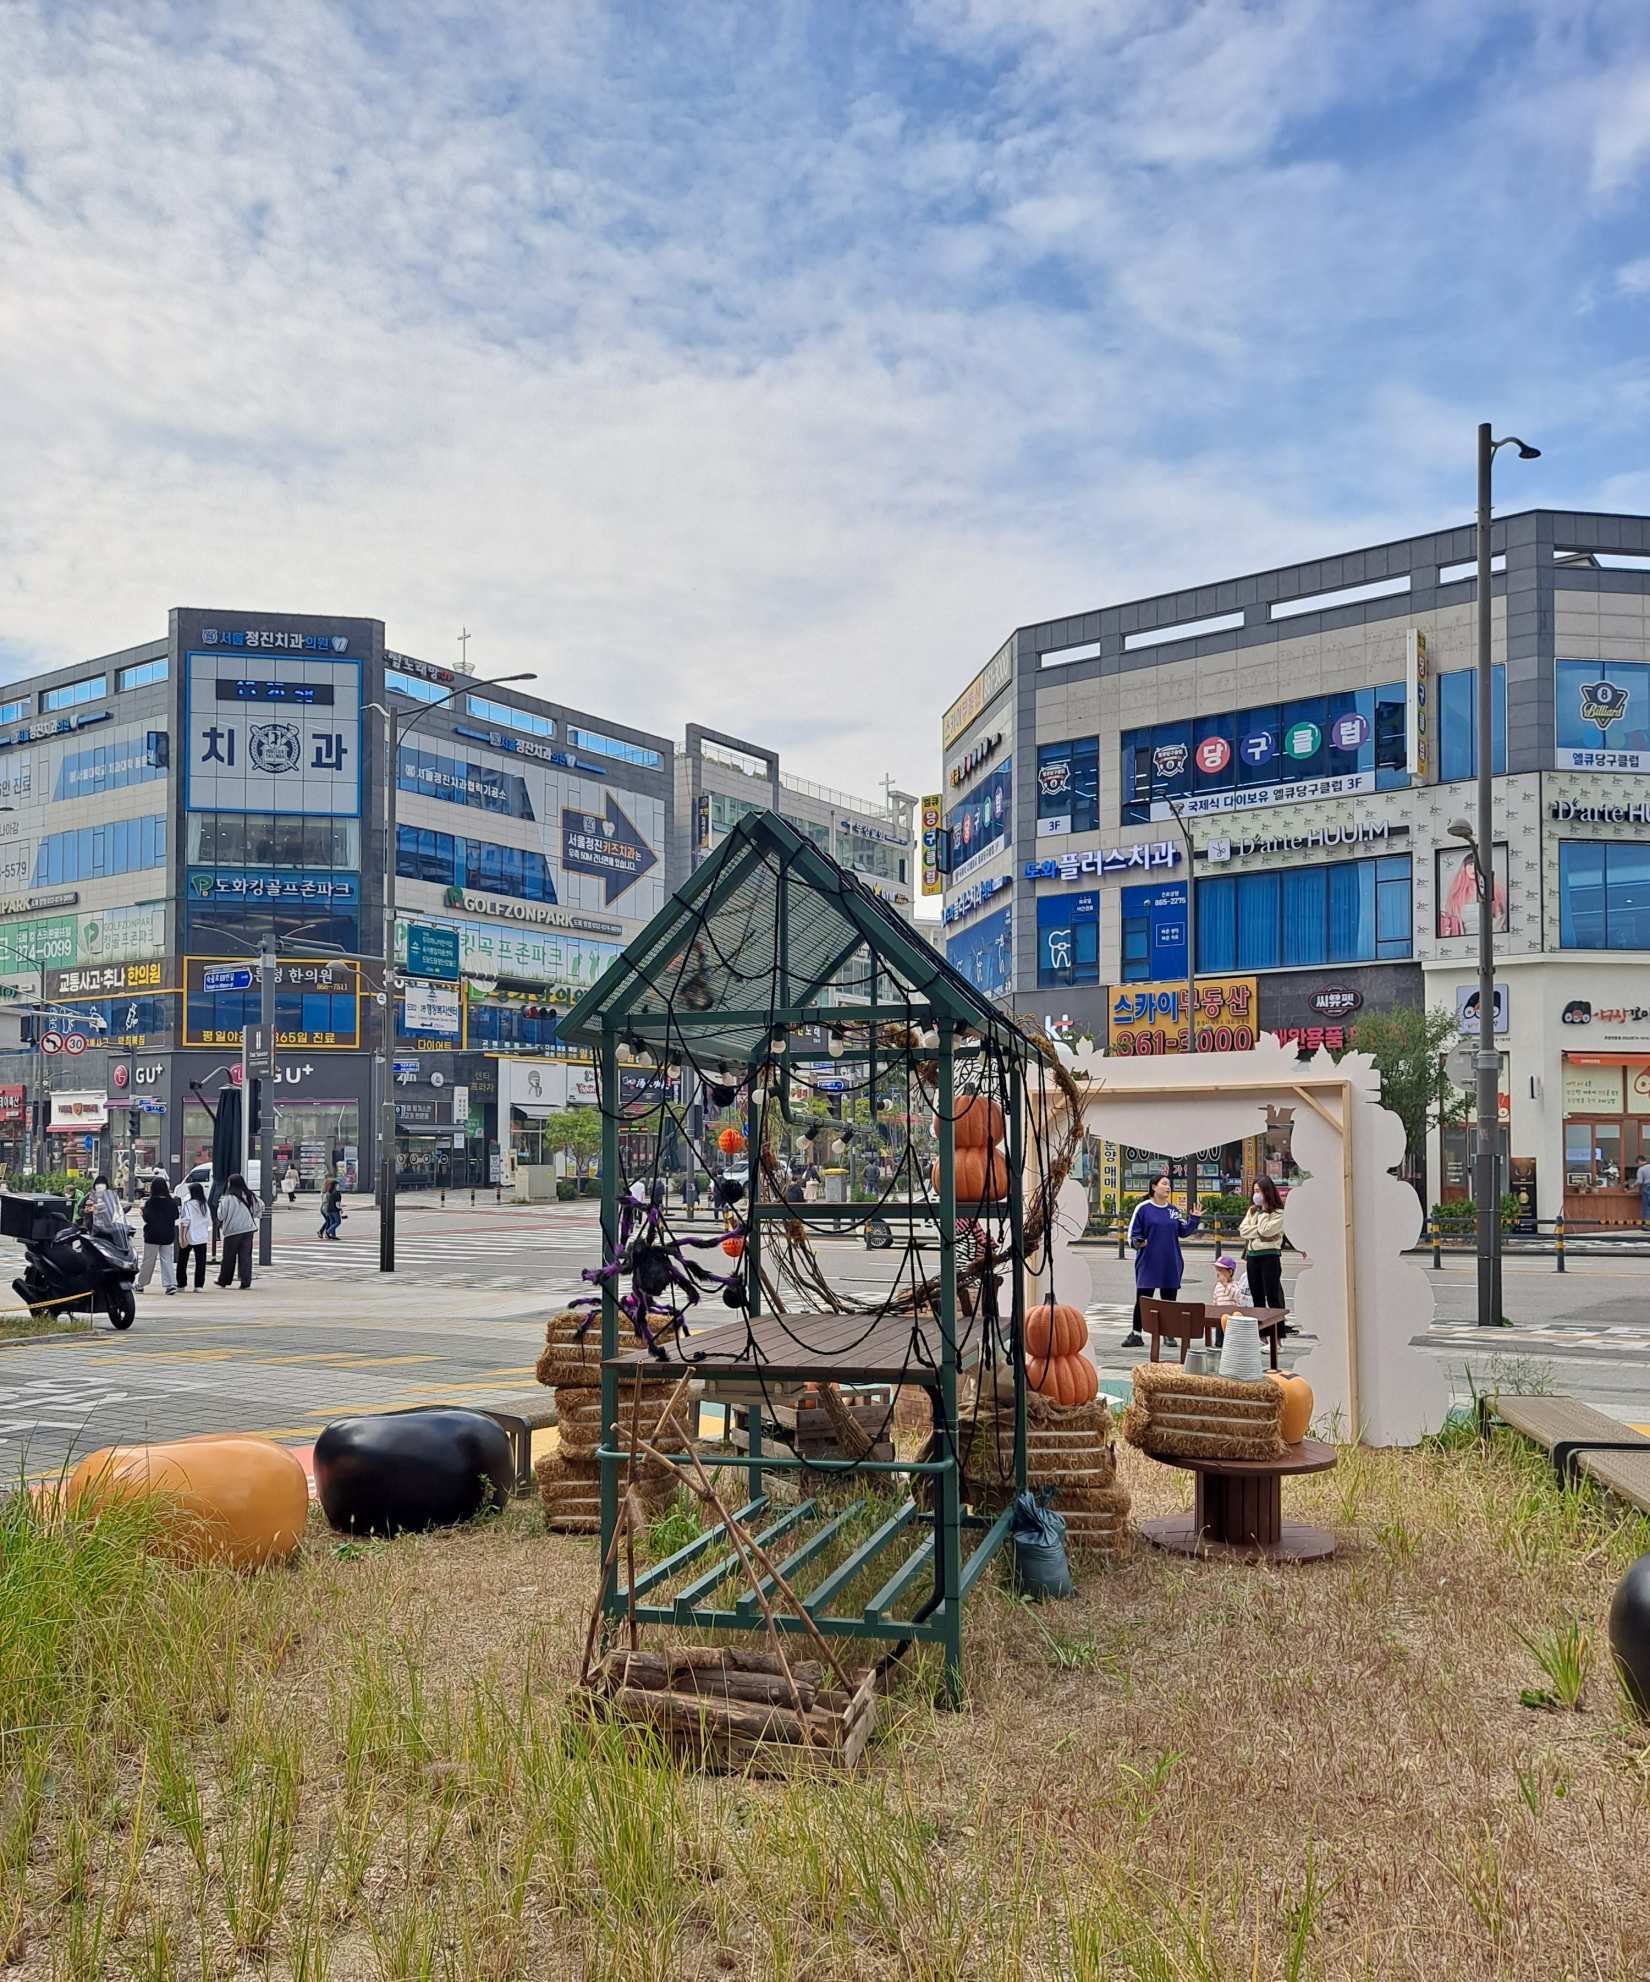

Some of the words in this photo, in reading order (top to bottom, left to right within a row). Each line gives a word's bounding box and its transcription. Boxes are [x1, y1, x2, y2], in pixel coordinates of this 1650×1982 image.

[219, 631, 329, 650] 서울정진치과의원
[1584, 703, 1623, 717] Billiard
[1572, 752, 1641, 768] 엘큐당구클럽
[1273, 779, 1343, 800] 엘큐당구클럽
[1347, 777, 1363, 790] 3F
[1049, 820, 1061, 831] 3F
[1024, 841, 1177, 881] 도화플러스치과
[216, 878, 351, 897] 도화킹골프존파크
[464, 895, 574, 928] GOLFZONPARK
[127, 963, 161, 987] 한의원
[288, 967, 333, 985] 한의원
[1113, 985, 1251, 1025] 스카이부동산
[69, 1039, 82, 1049] 30
[312, 1032, 337, 1044] 진료
